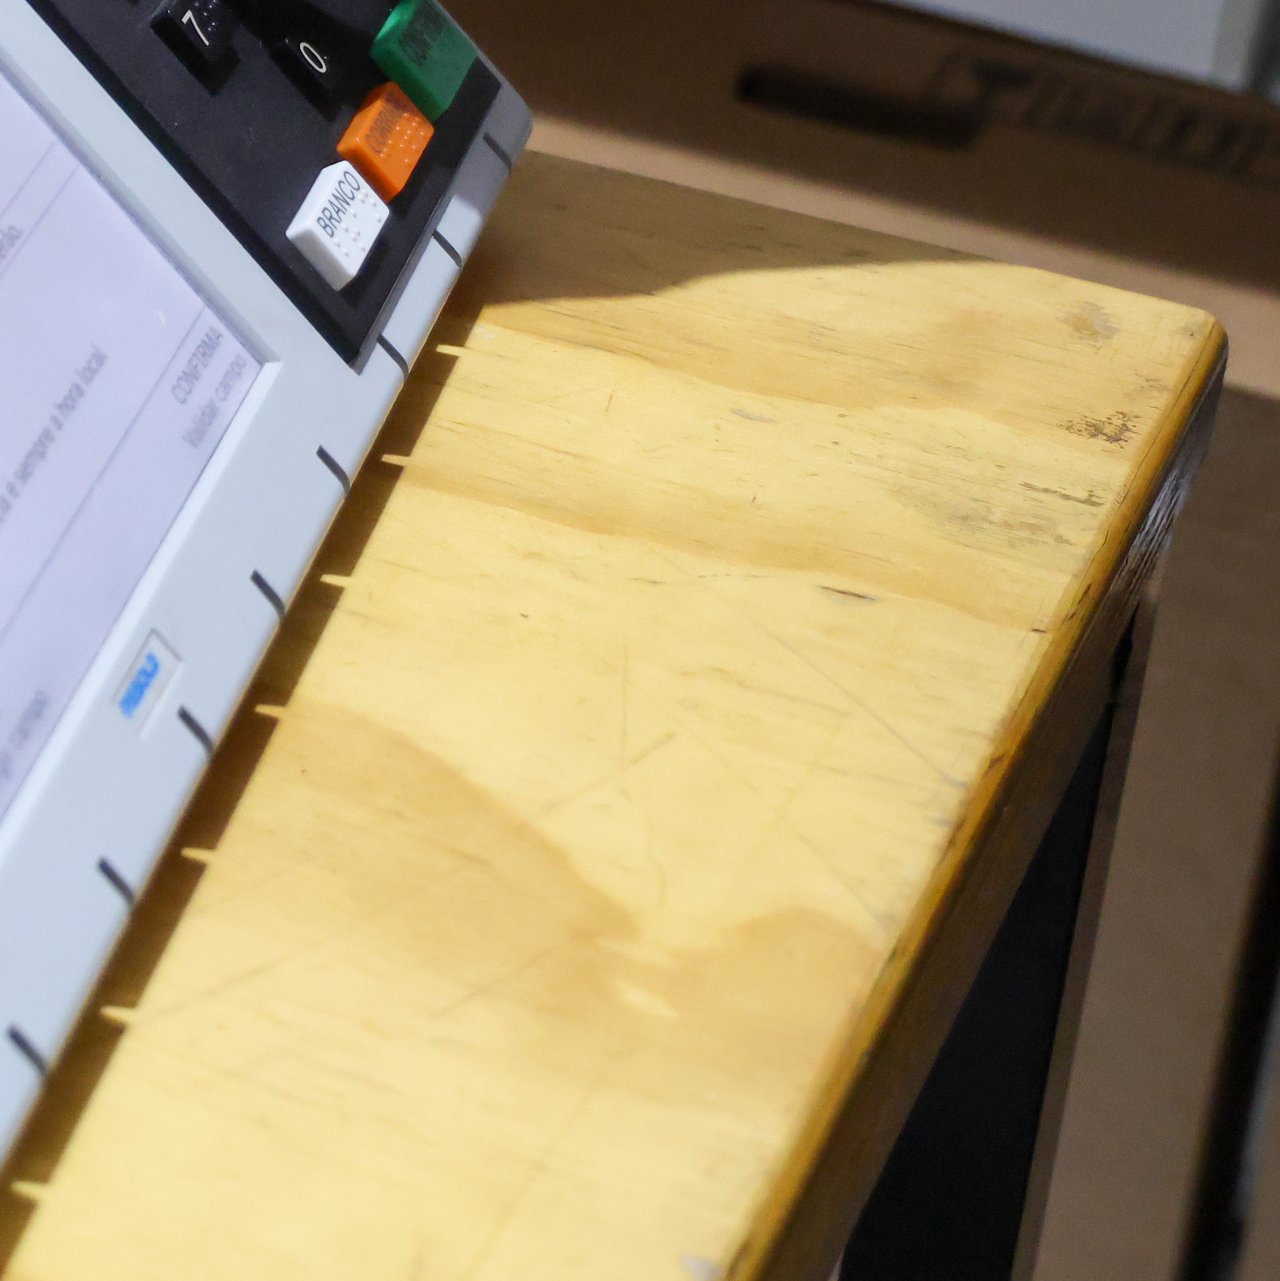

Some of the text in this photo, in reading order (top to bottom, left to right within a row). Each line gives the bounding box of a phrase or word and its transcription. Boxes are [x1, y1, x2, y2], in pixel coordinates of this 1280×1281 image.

[181, 10, 210, 47] 7
[300, 42, 327, 74] 0
[316, 170, 361, 239] BRANCO
